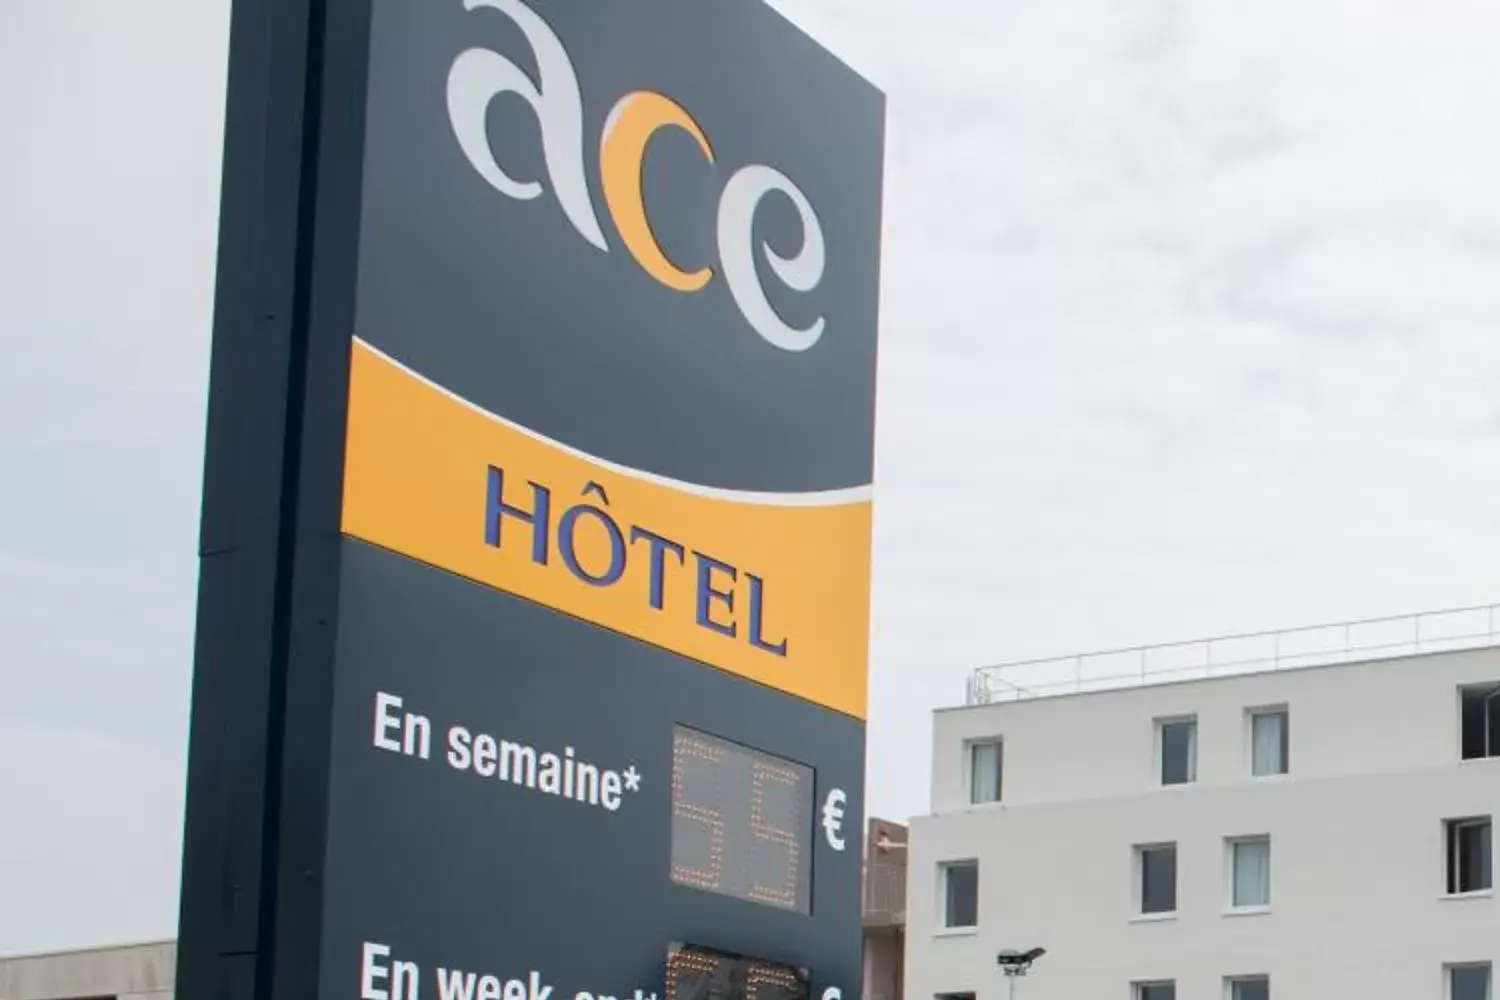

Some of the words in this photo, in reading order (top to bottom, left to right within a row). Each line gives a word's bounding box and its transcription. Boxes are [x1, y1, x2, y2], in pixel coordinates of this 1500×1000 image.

[446, 0, 826, 352] ace
[483, 464, 788, 658] HÔTEL
[372, 691, 431, 760] En
[822, 788, 848, 850] €
